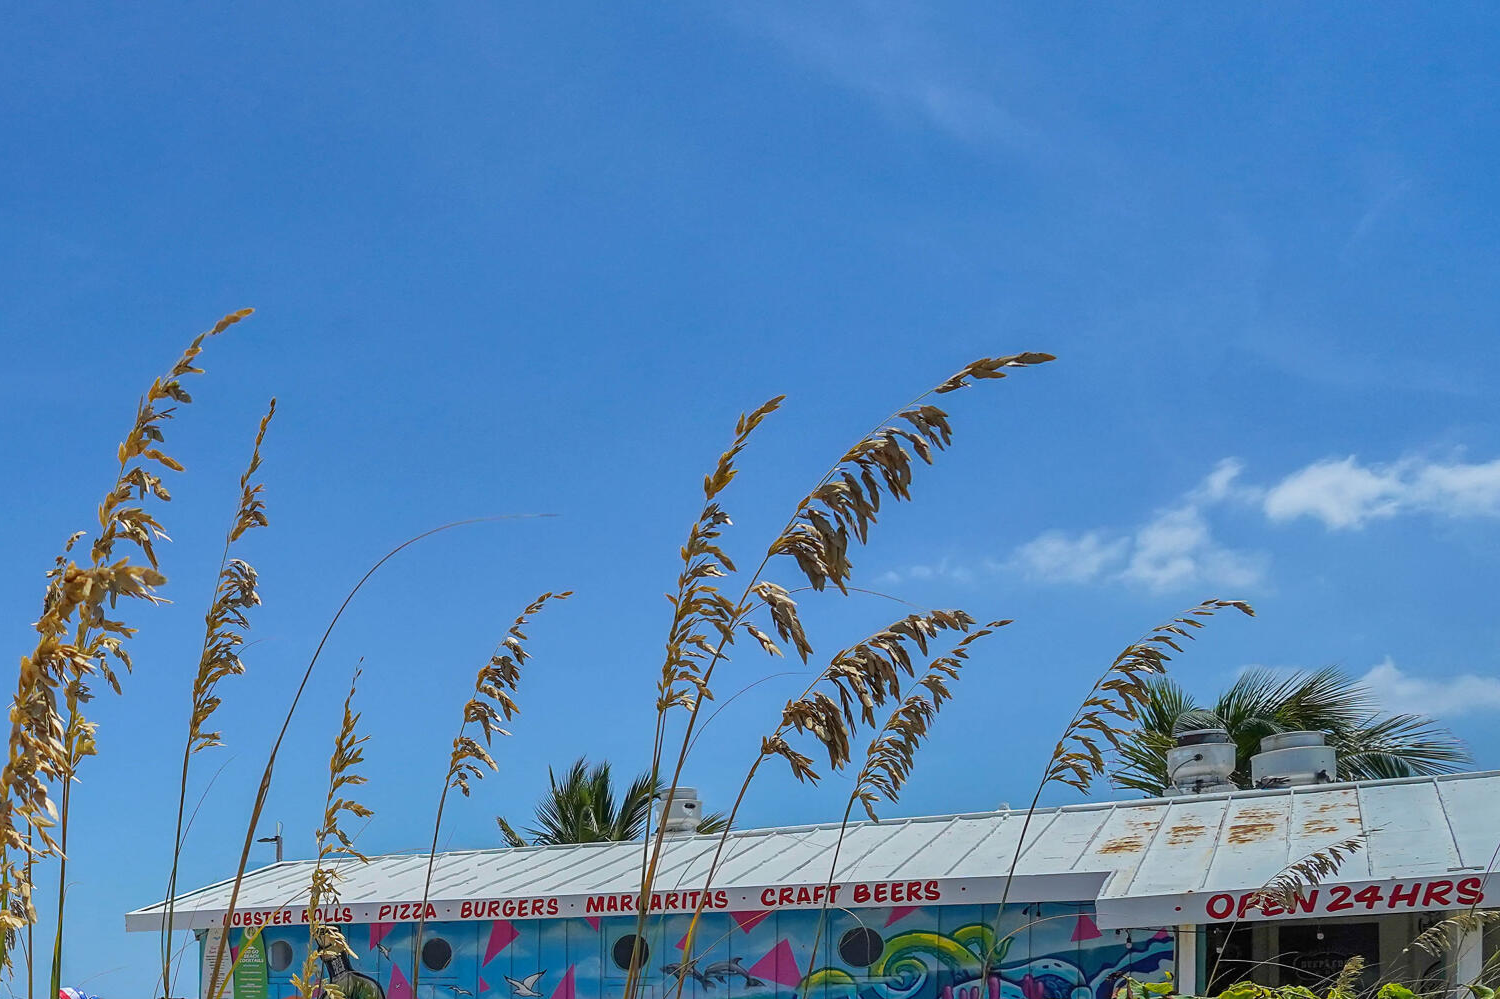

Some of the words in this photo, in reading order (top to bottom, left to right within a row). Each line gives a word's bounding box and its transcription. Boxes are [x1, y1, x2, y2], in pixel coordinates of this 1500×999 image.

[301, 907, 353, 922] ROLLS
[378, 903, 437, 921] PIZZA
[460, 898, 559, 919] BURGERS
[761, 885, 841, 906] CRAFT
[853, 880, 941, 903] BEERS
[1206, 890, 1319, 919] OPEN
